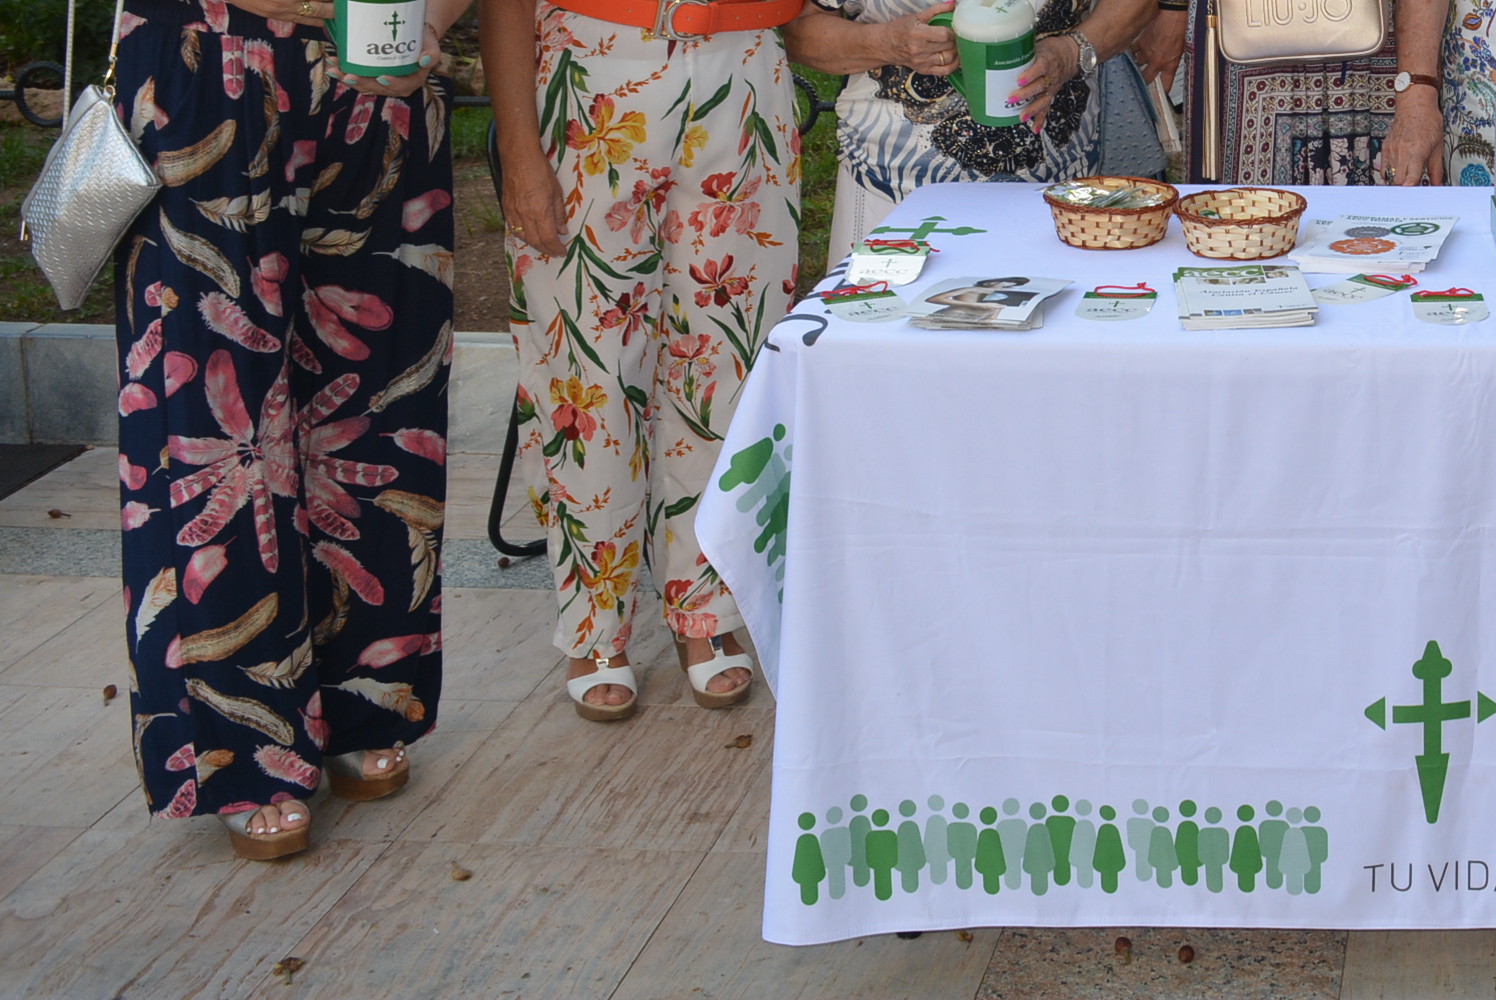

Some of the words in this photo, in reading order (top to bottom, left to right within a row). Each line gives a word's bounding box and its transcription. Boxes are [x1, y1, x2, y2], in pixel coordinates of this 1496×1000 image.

[366, 40, 417, 55] aecc
[1183, 268, 1260, 278] aecc
[1363, 863, 1414, 894] TU
